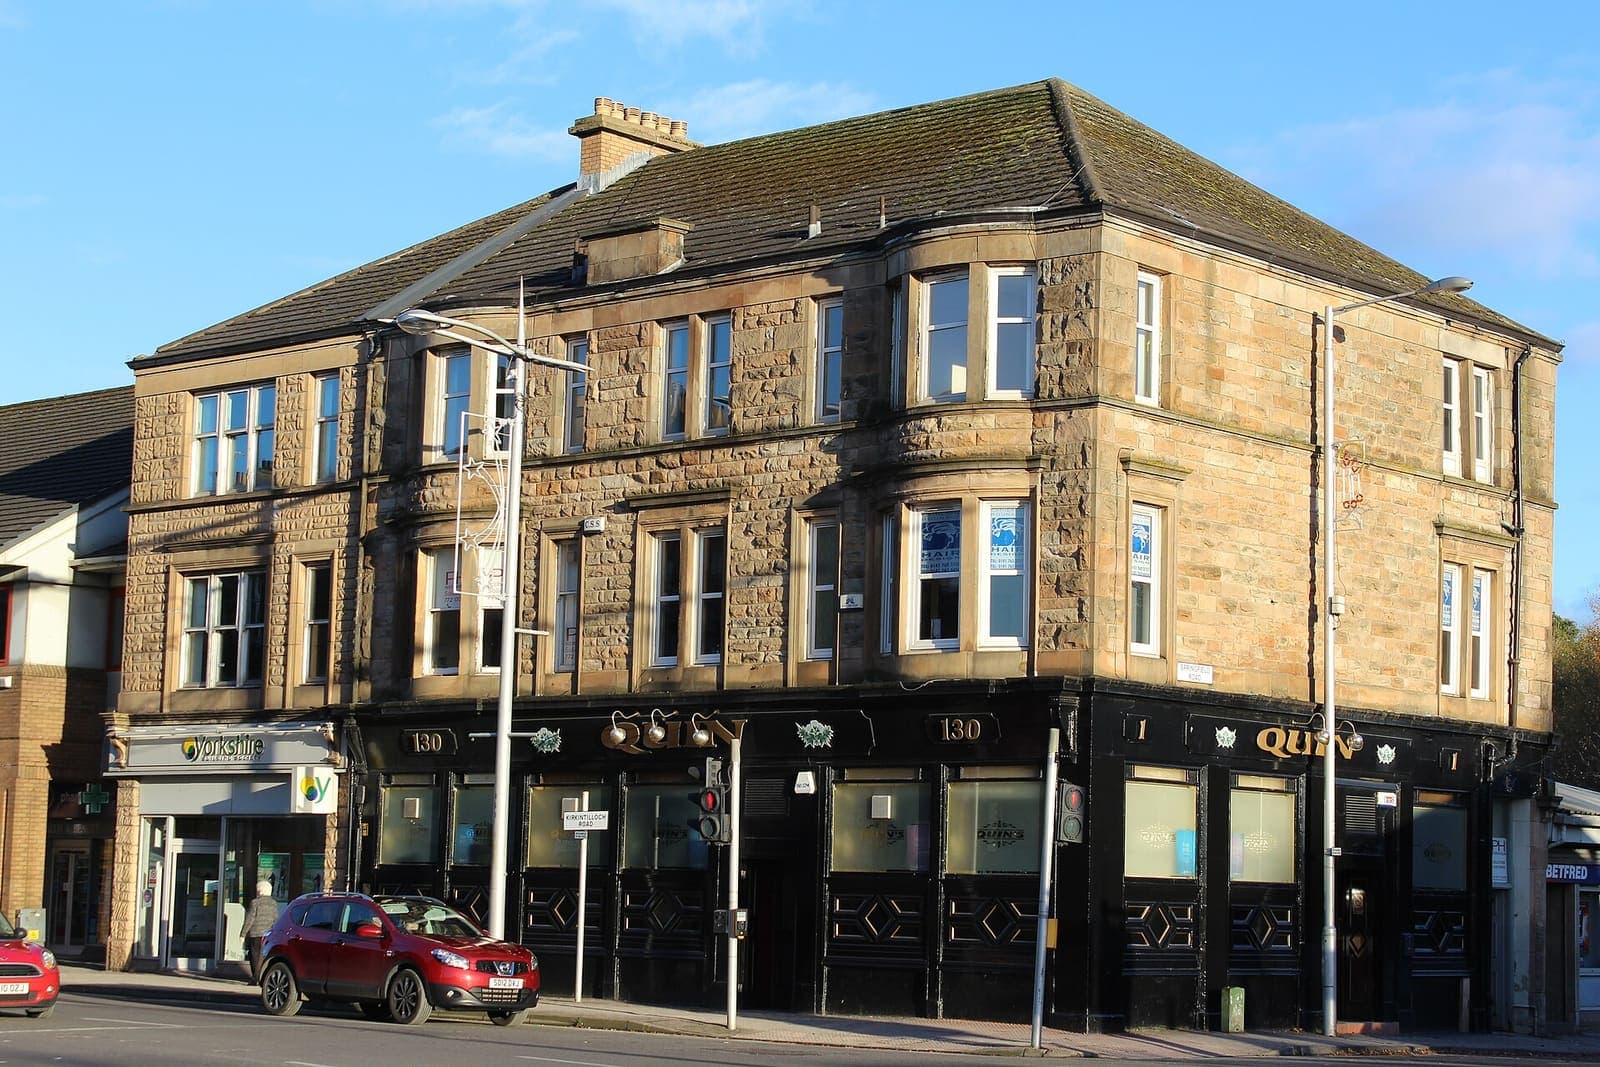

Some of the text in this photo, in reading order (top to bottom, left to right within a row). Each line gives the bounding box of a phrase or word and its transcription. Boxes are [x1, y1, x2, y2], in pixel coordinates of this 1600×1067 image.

[940, 718, 981, 741] 130
[1139, 719, 1147, 740] 1
[411, 732, 442, 752] 130
[1450, 752, 1459, 771] 1
[1545, 864, 1588, 880] BETFRED
